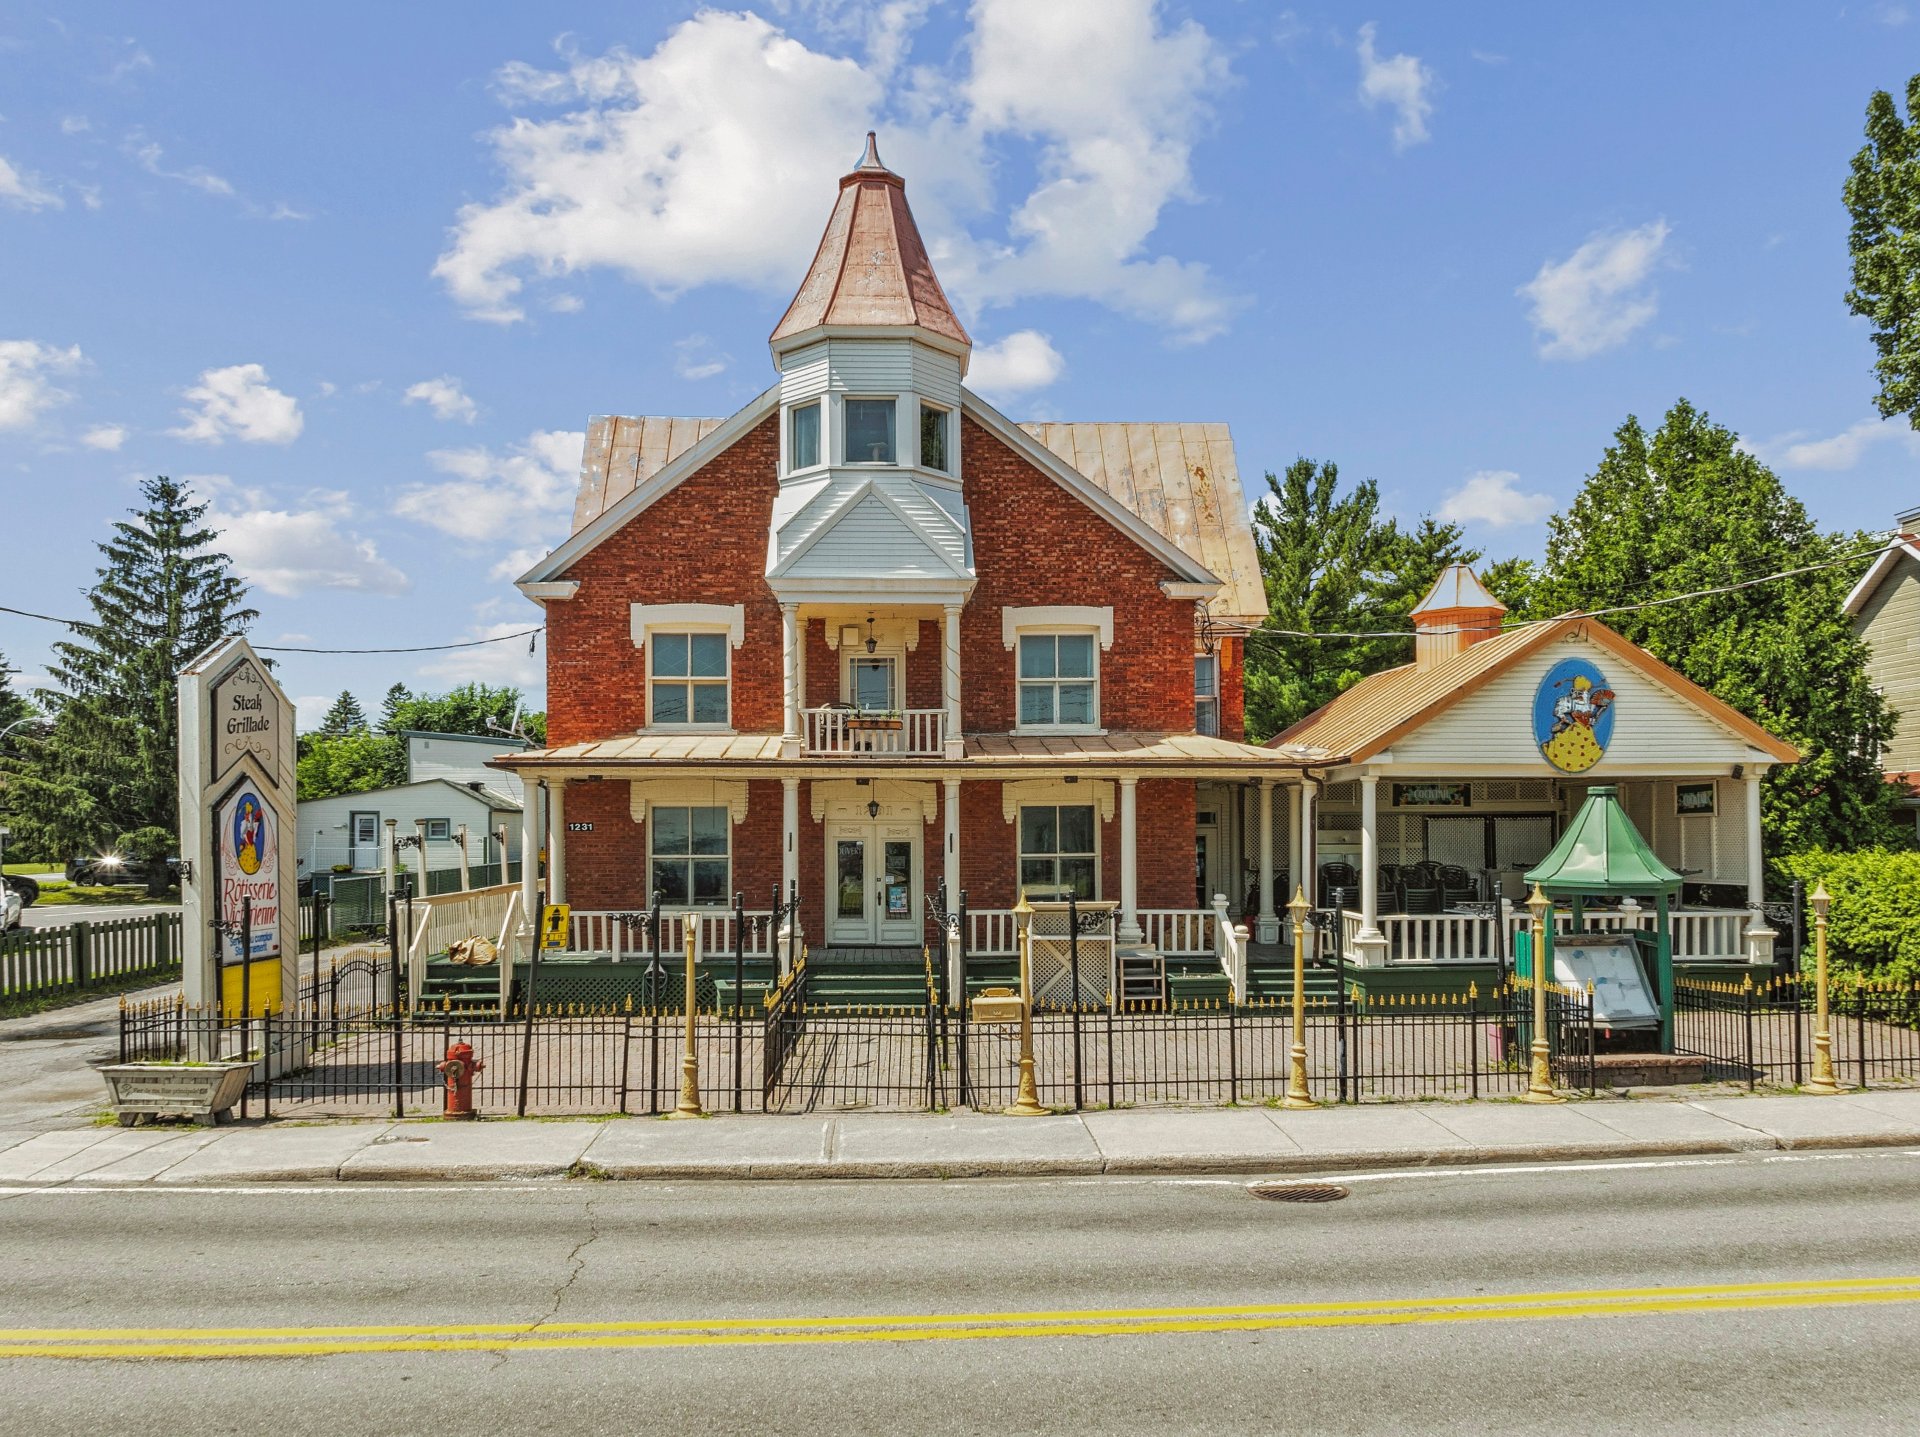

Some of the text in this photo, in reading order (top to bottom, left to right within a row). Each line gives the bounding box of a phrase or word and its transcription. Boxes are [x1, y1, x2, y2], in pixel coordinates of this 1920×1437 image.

[232, 693, 262, 712] Steak
[227, 715, 270, 734] Grillade
[569, 823, 593, 831] 1231
[223, 878, 277, 905] Rôtisserie
[224, 904, 277, 928] Victrienne
